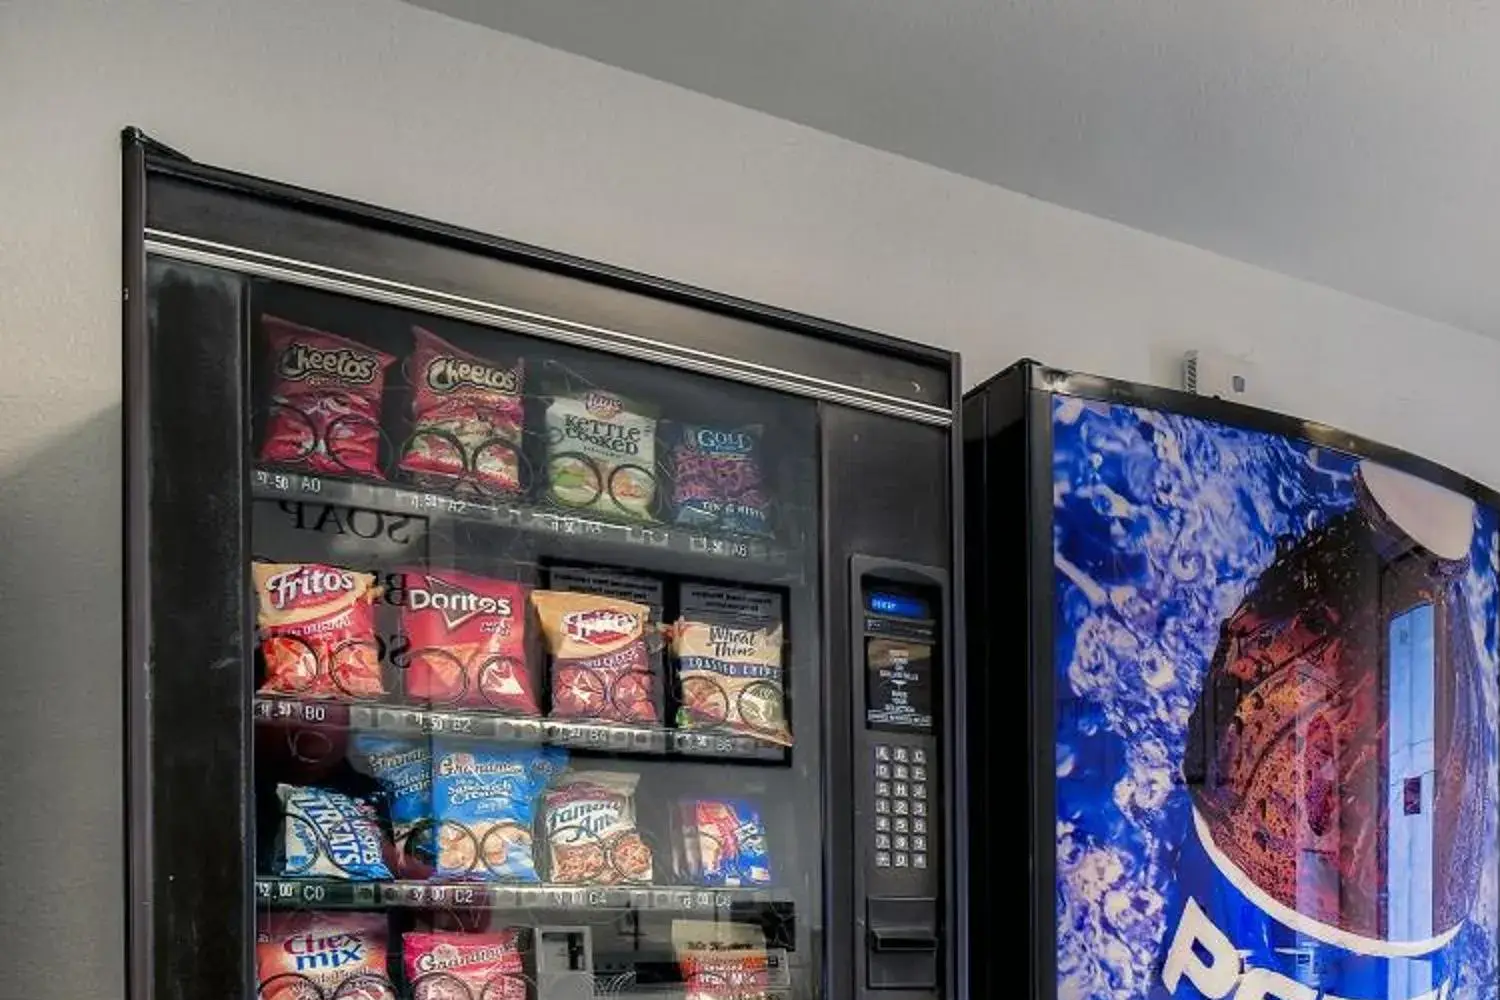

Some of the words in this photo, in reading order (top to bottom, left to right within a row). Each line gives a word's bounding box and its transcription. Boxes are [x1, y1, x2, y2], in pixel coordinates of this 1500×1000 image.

[279, 344, 377, 382] Cheetos
[428, 357, 518, 394] Cheetos
[267, 566, 354, 609] Fritos
[411, 589, 512, 616] Doritos
[293, 800, 362, 866] TREATS
[284, 934, 362, 956] Chex
[295, 943, 363, 971] mix
